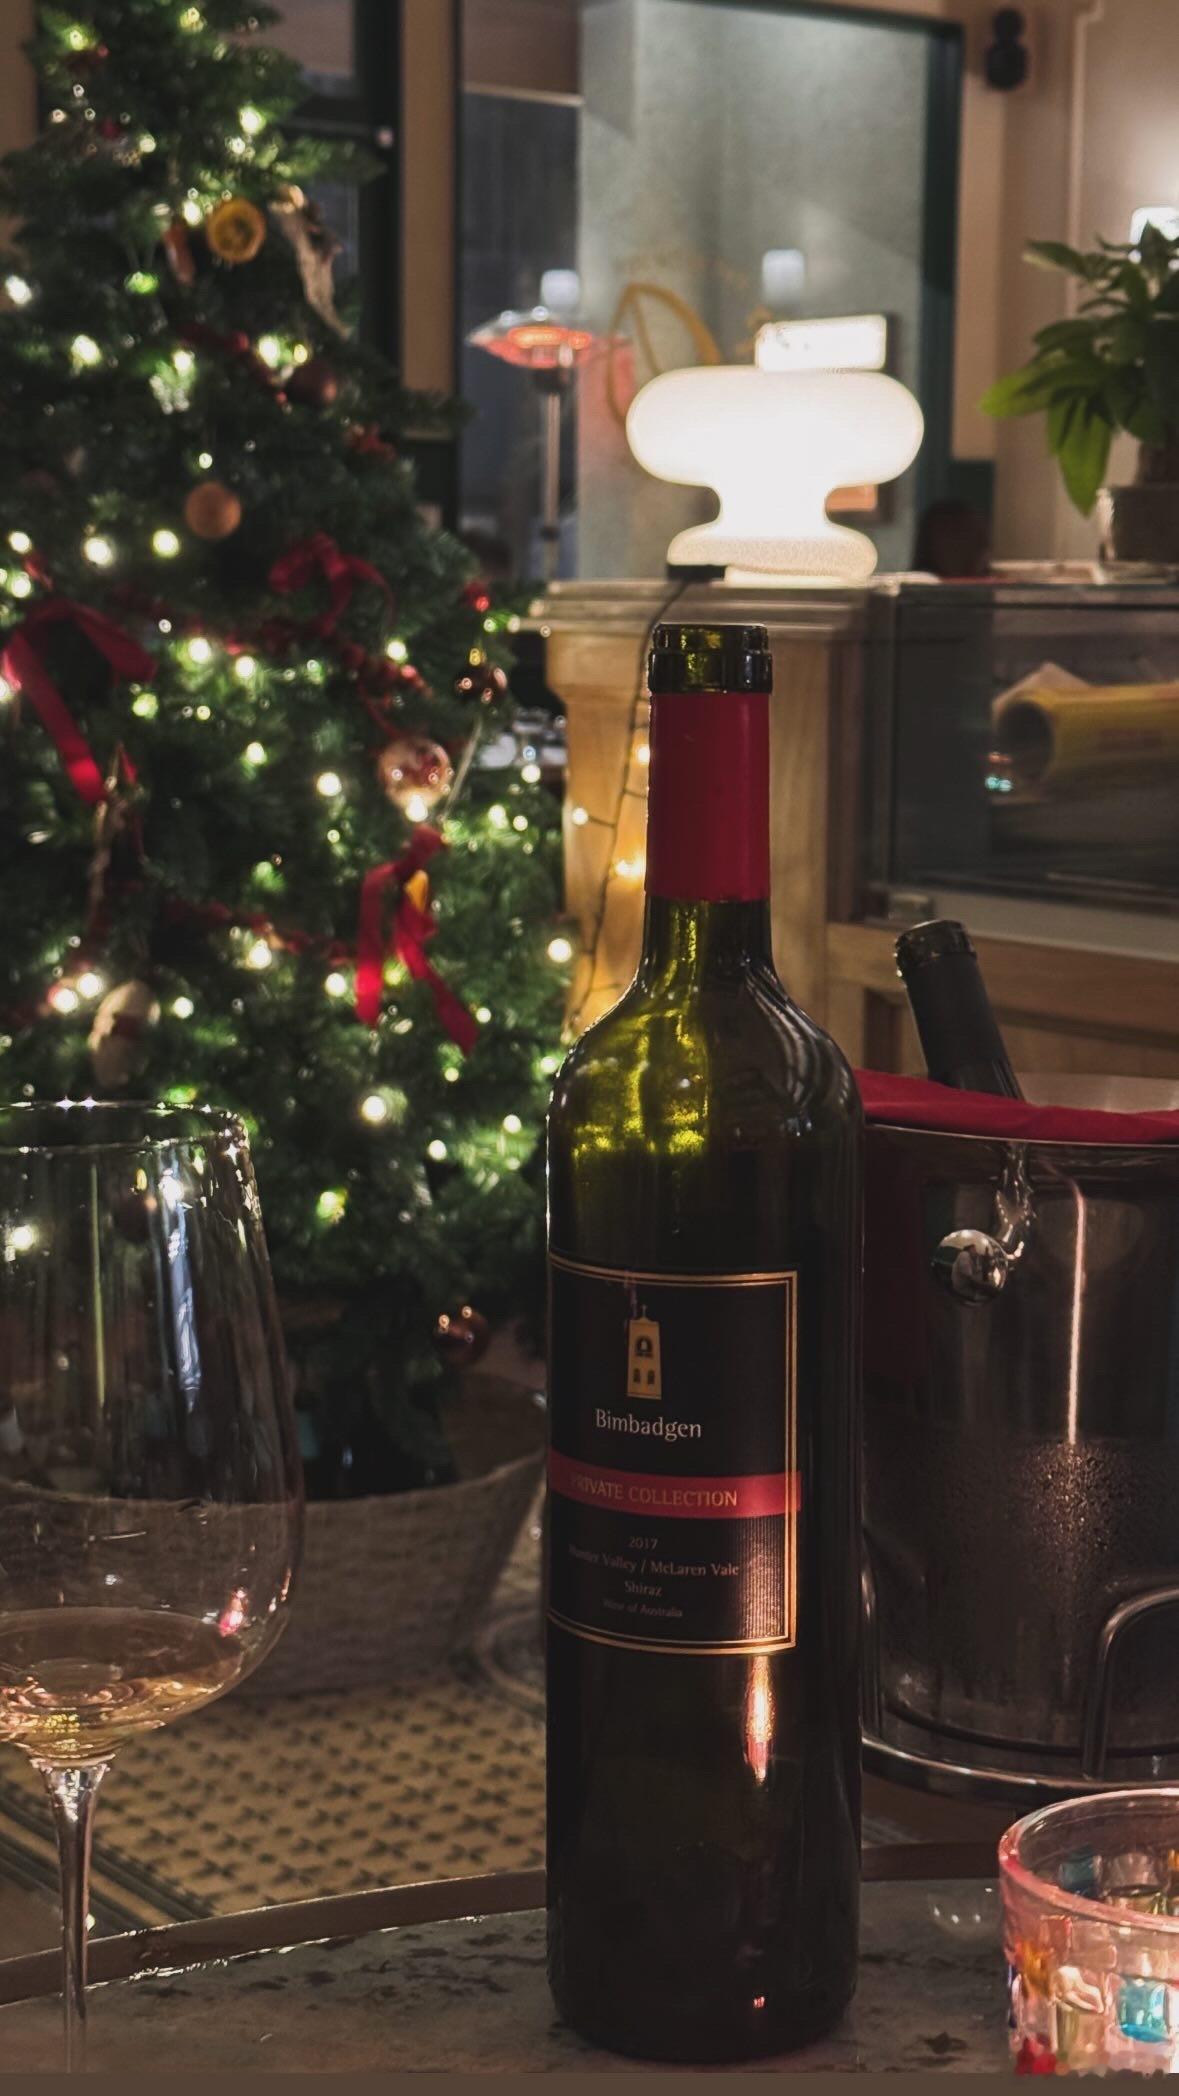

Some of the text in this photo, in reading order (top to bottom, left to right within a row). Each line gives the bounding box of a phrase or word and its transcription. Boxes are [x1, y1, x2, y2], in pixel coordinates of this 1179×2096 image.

[595, 1408, 702, 1441] Bimbadgen
[570, 1473, 738, 1507] PRIVATE COLLECTION
[627, 1536, 659, 1550] 2017
[601, 1552, 637, 1574] Valley
[640, 1557, 646, 1576] /
[650, 1560, 706, 1577] McLaren
[710, 1562, 740, 1576] Vale
[624, 1580, 663, 1597] Shiraz
[640, 1603, 683, 1618] Australia
